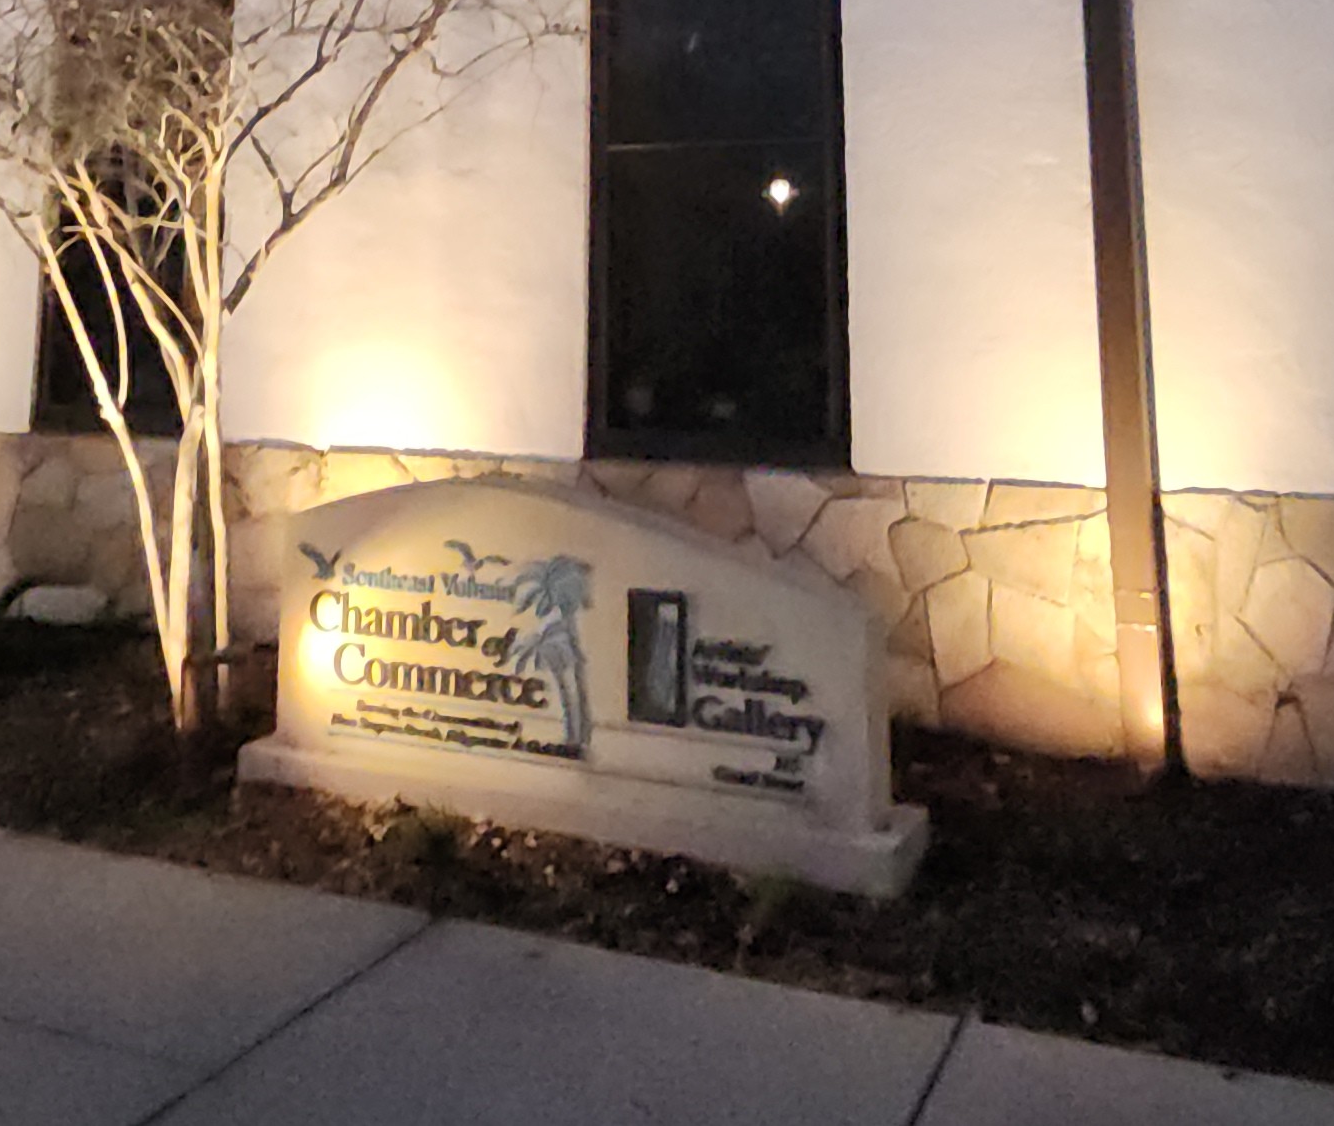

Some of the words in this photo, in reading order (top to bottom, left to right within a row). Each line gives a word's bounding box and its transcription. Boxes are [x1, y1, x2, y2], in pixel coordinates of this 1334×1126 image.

[341, 562, 435, 593] Southeast
[309, 589, 488, 648] Chamber
[481, 627, 519, 667] of
[333, 642, 548, 708] Commerce
[692, 695, 826, 755] Gallery
